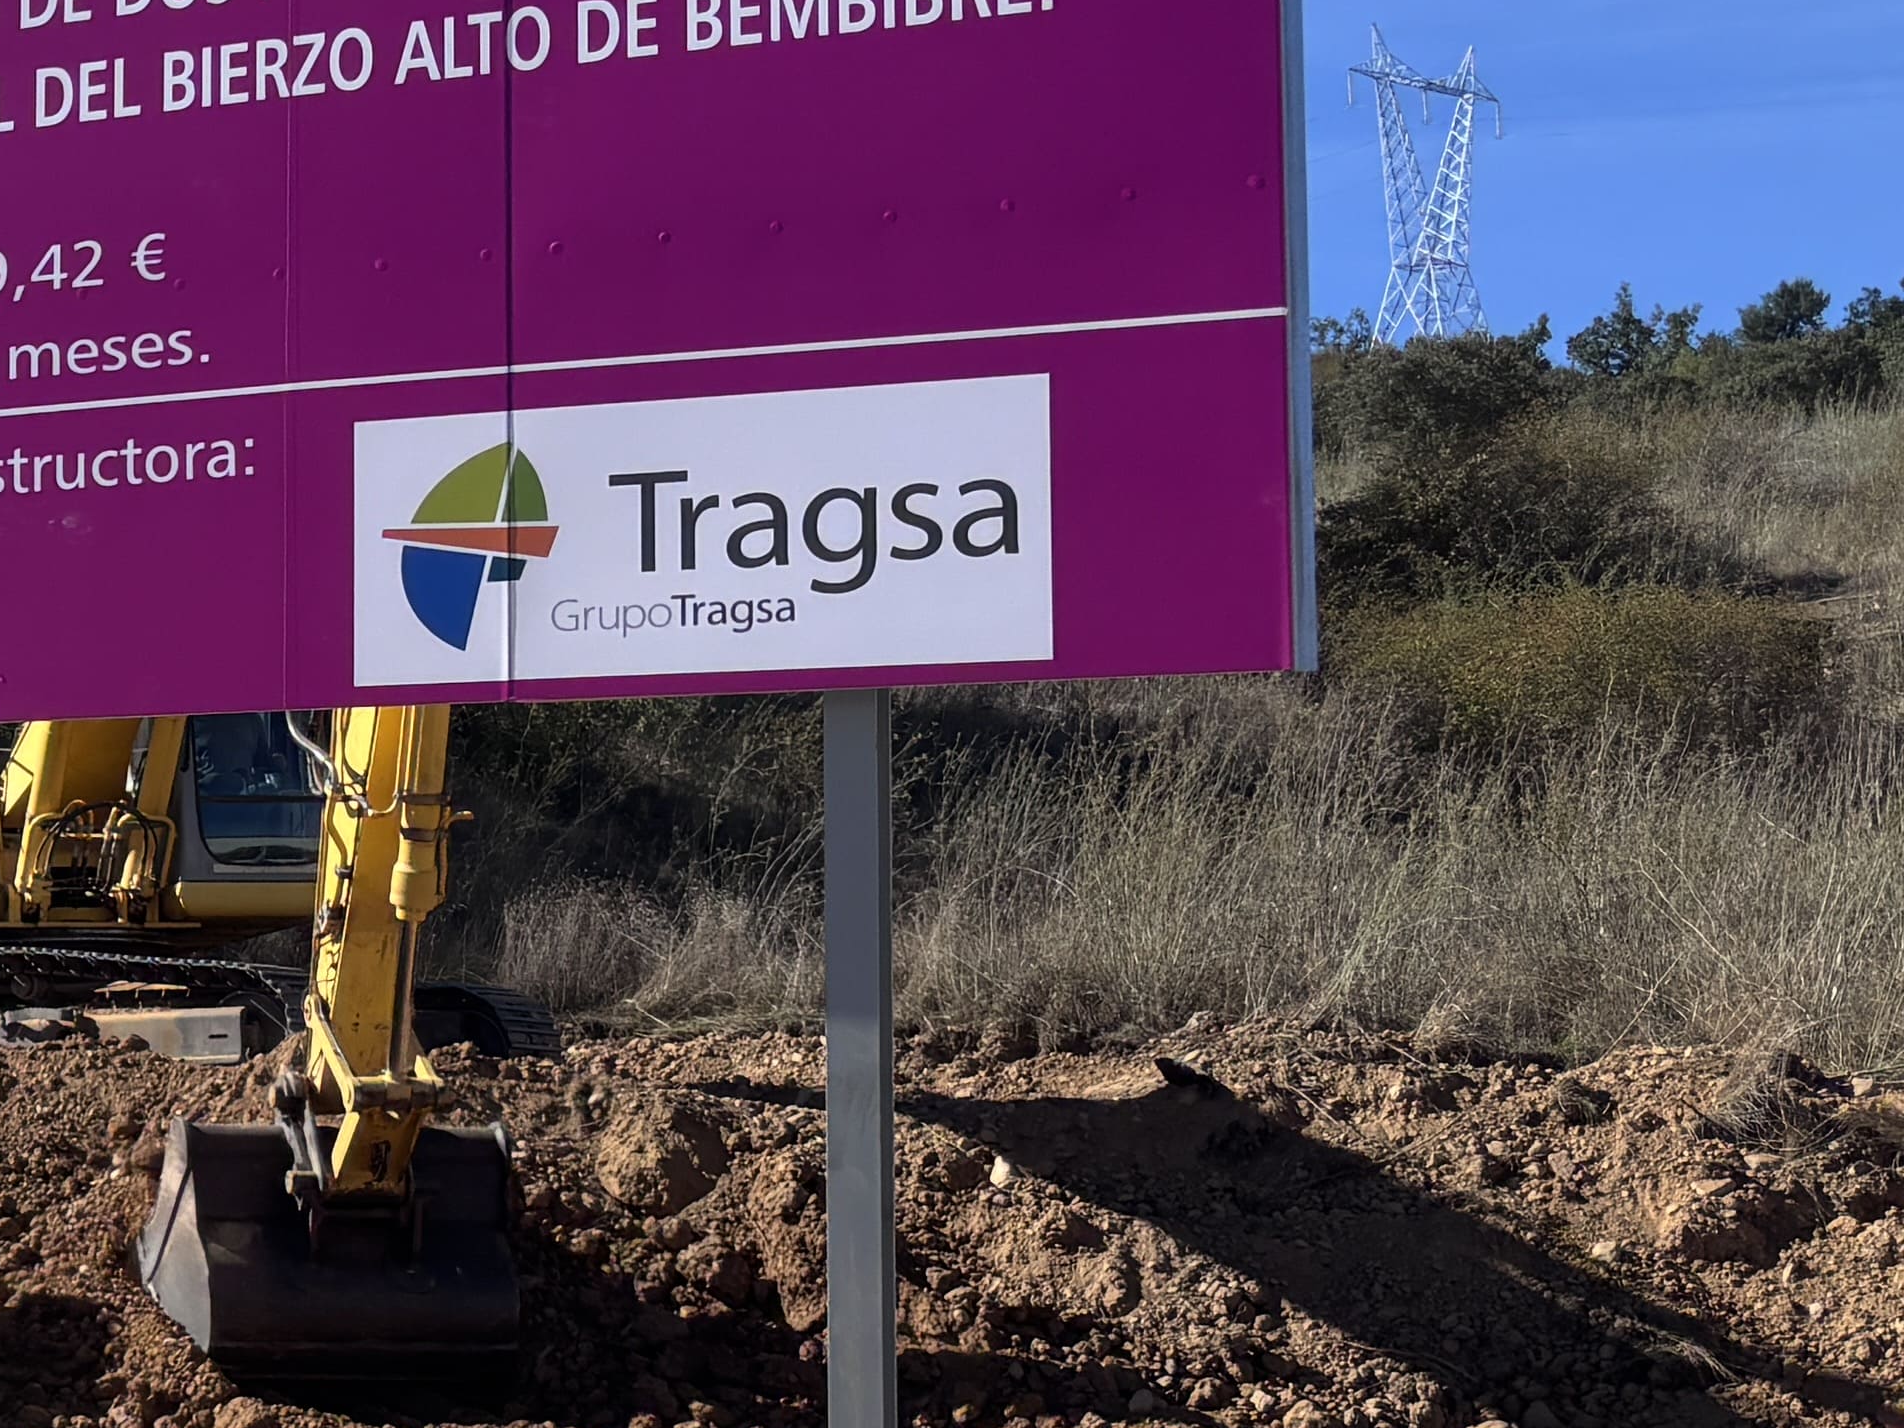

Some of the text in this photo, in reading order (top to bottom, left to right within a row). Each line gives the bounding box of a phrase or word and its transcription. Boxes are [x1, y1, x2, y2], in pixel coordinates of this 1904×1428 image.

[34, 56, 142, 127] DEL
[162, 26, 373, 112] BIERZO
[393, 5, 550, 85] ALTO
[130, 231, 166, 281] €
[7, 329, 210, 380] meses.
[607, 468, 1021, 595] Tragsa
[549, 592, 796, 639] GrupoTragsa
